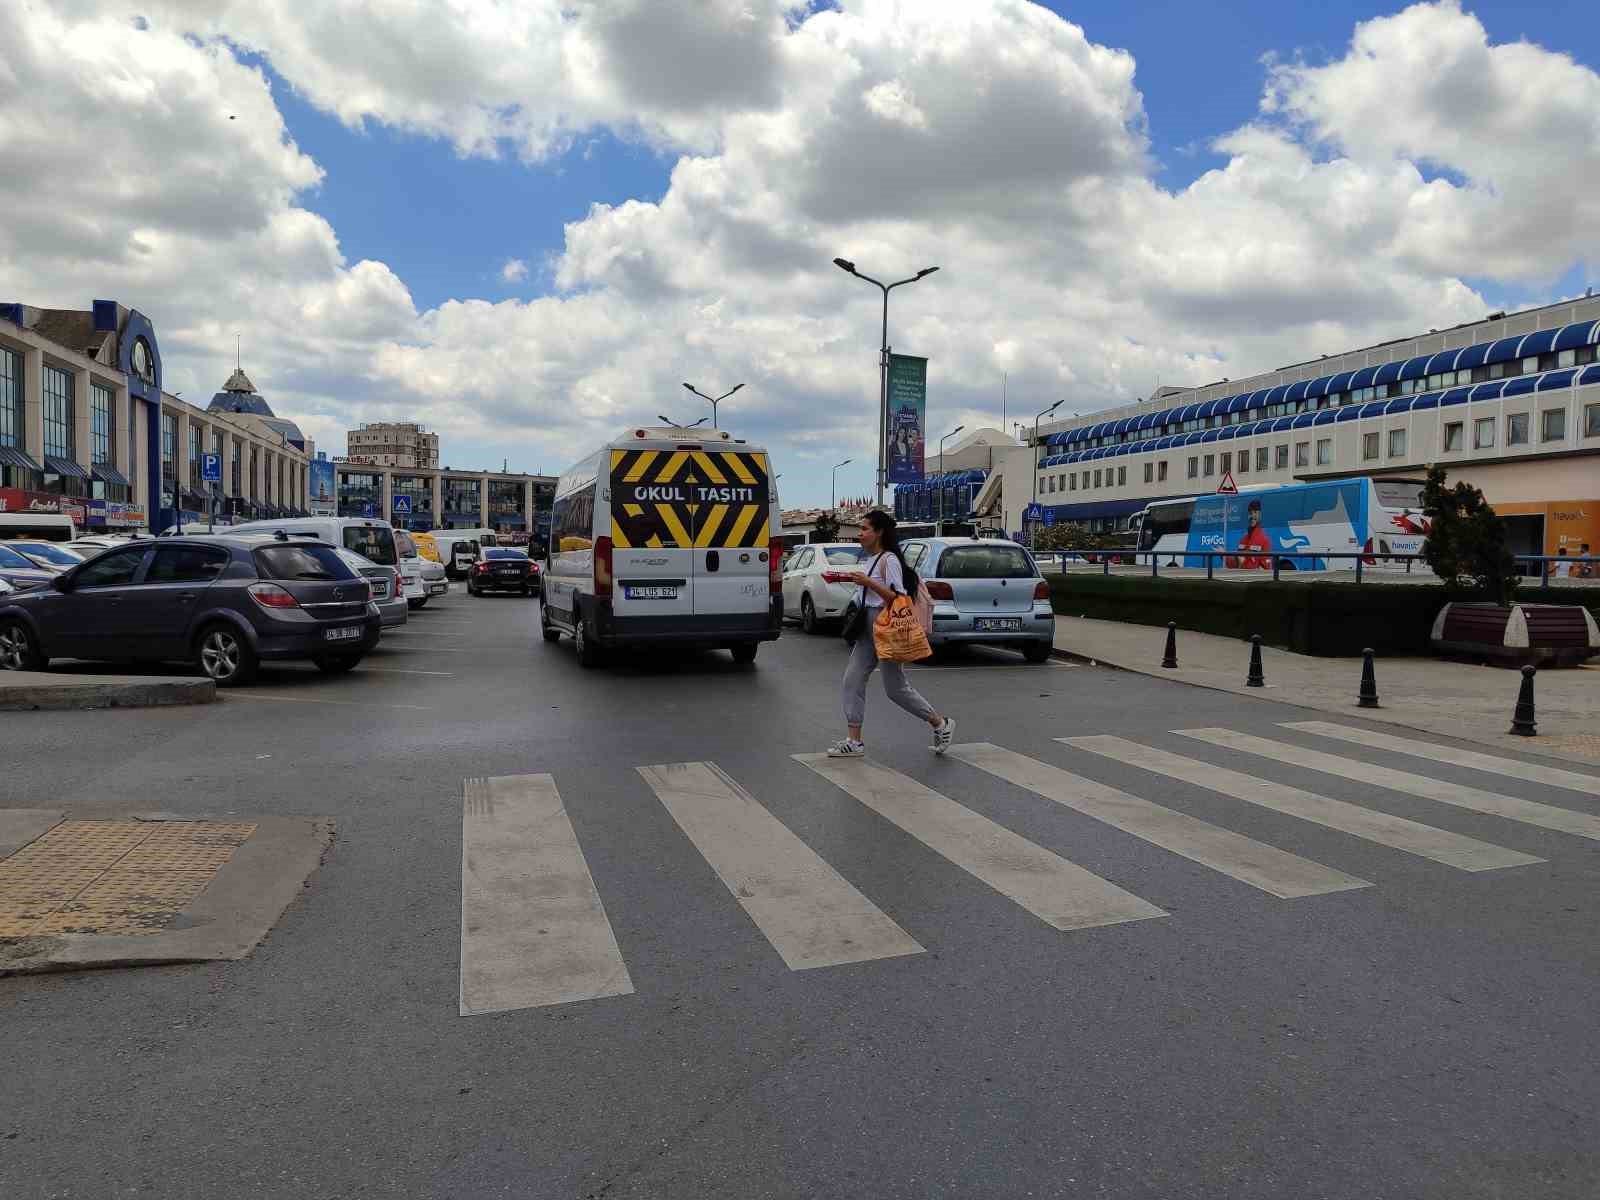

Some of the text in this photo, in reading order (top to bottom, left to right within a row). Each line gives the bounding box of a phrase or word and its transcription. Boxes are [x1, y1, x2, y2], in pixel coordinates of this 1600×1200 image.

[206, 455, 217, 470] P
[634, 486, 752, 503] OKUL TAŞITI
